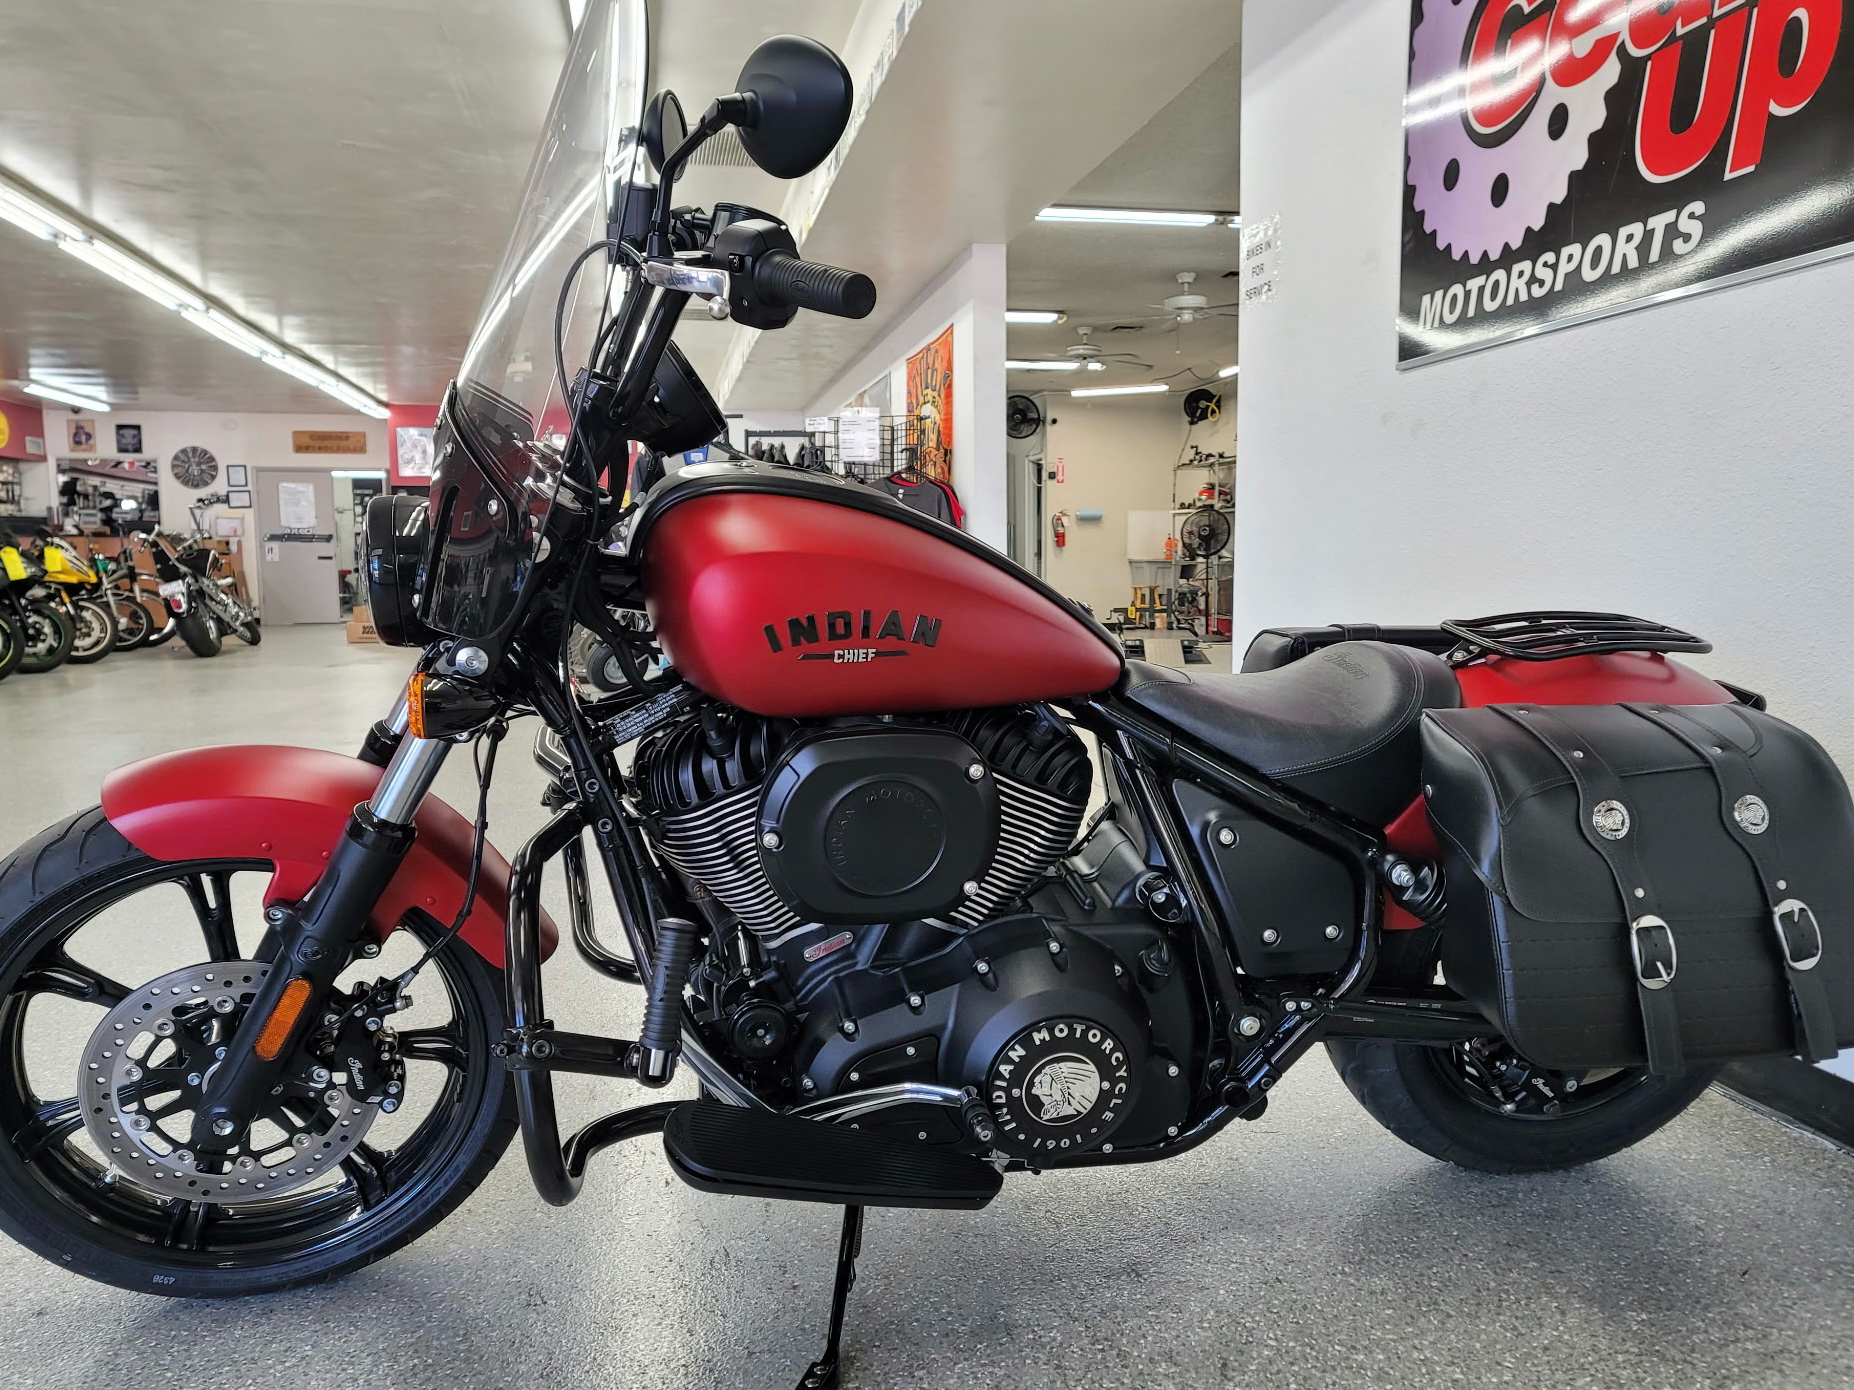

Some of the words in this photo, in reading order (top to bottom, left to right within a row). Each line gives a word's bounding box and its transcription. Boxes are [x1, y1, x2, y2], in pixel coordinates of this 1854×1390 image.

[1464, 0, 1748, 134] Ge
[1251, 263, 1265, 278] FOR
[1418, 200, 1707, 332] MOTORSPORTS
[763, 609, 942, 653] INDIAN
[833, 648, 877, 663] CHIEF
[811, 938, 846, 958] Indian
[347, 1057, 365, 1090] Indian
[992, 1044, 1027, 1131] INDIAN
[1032, 1023, 1128, 1122] MOTORCYCLE
[1033, 1134, 1083, 1149] 1901
